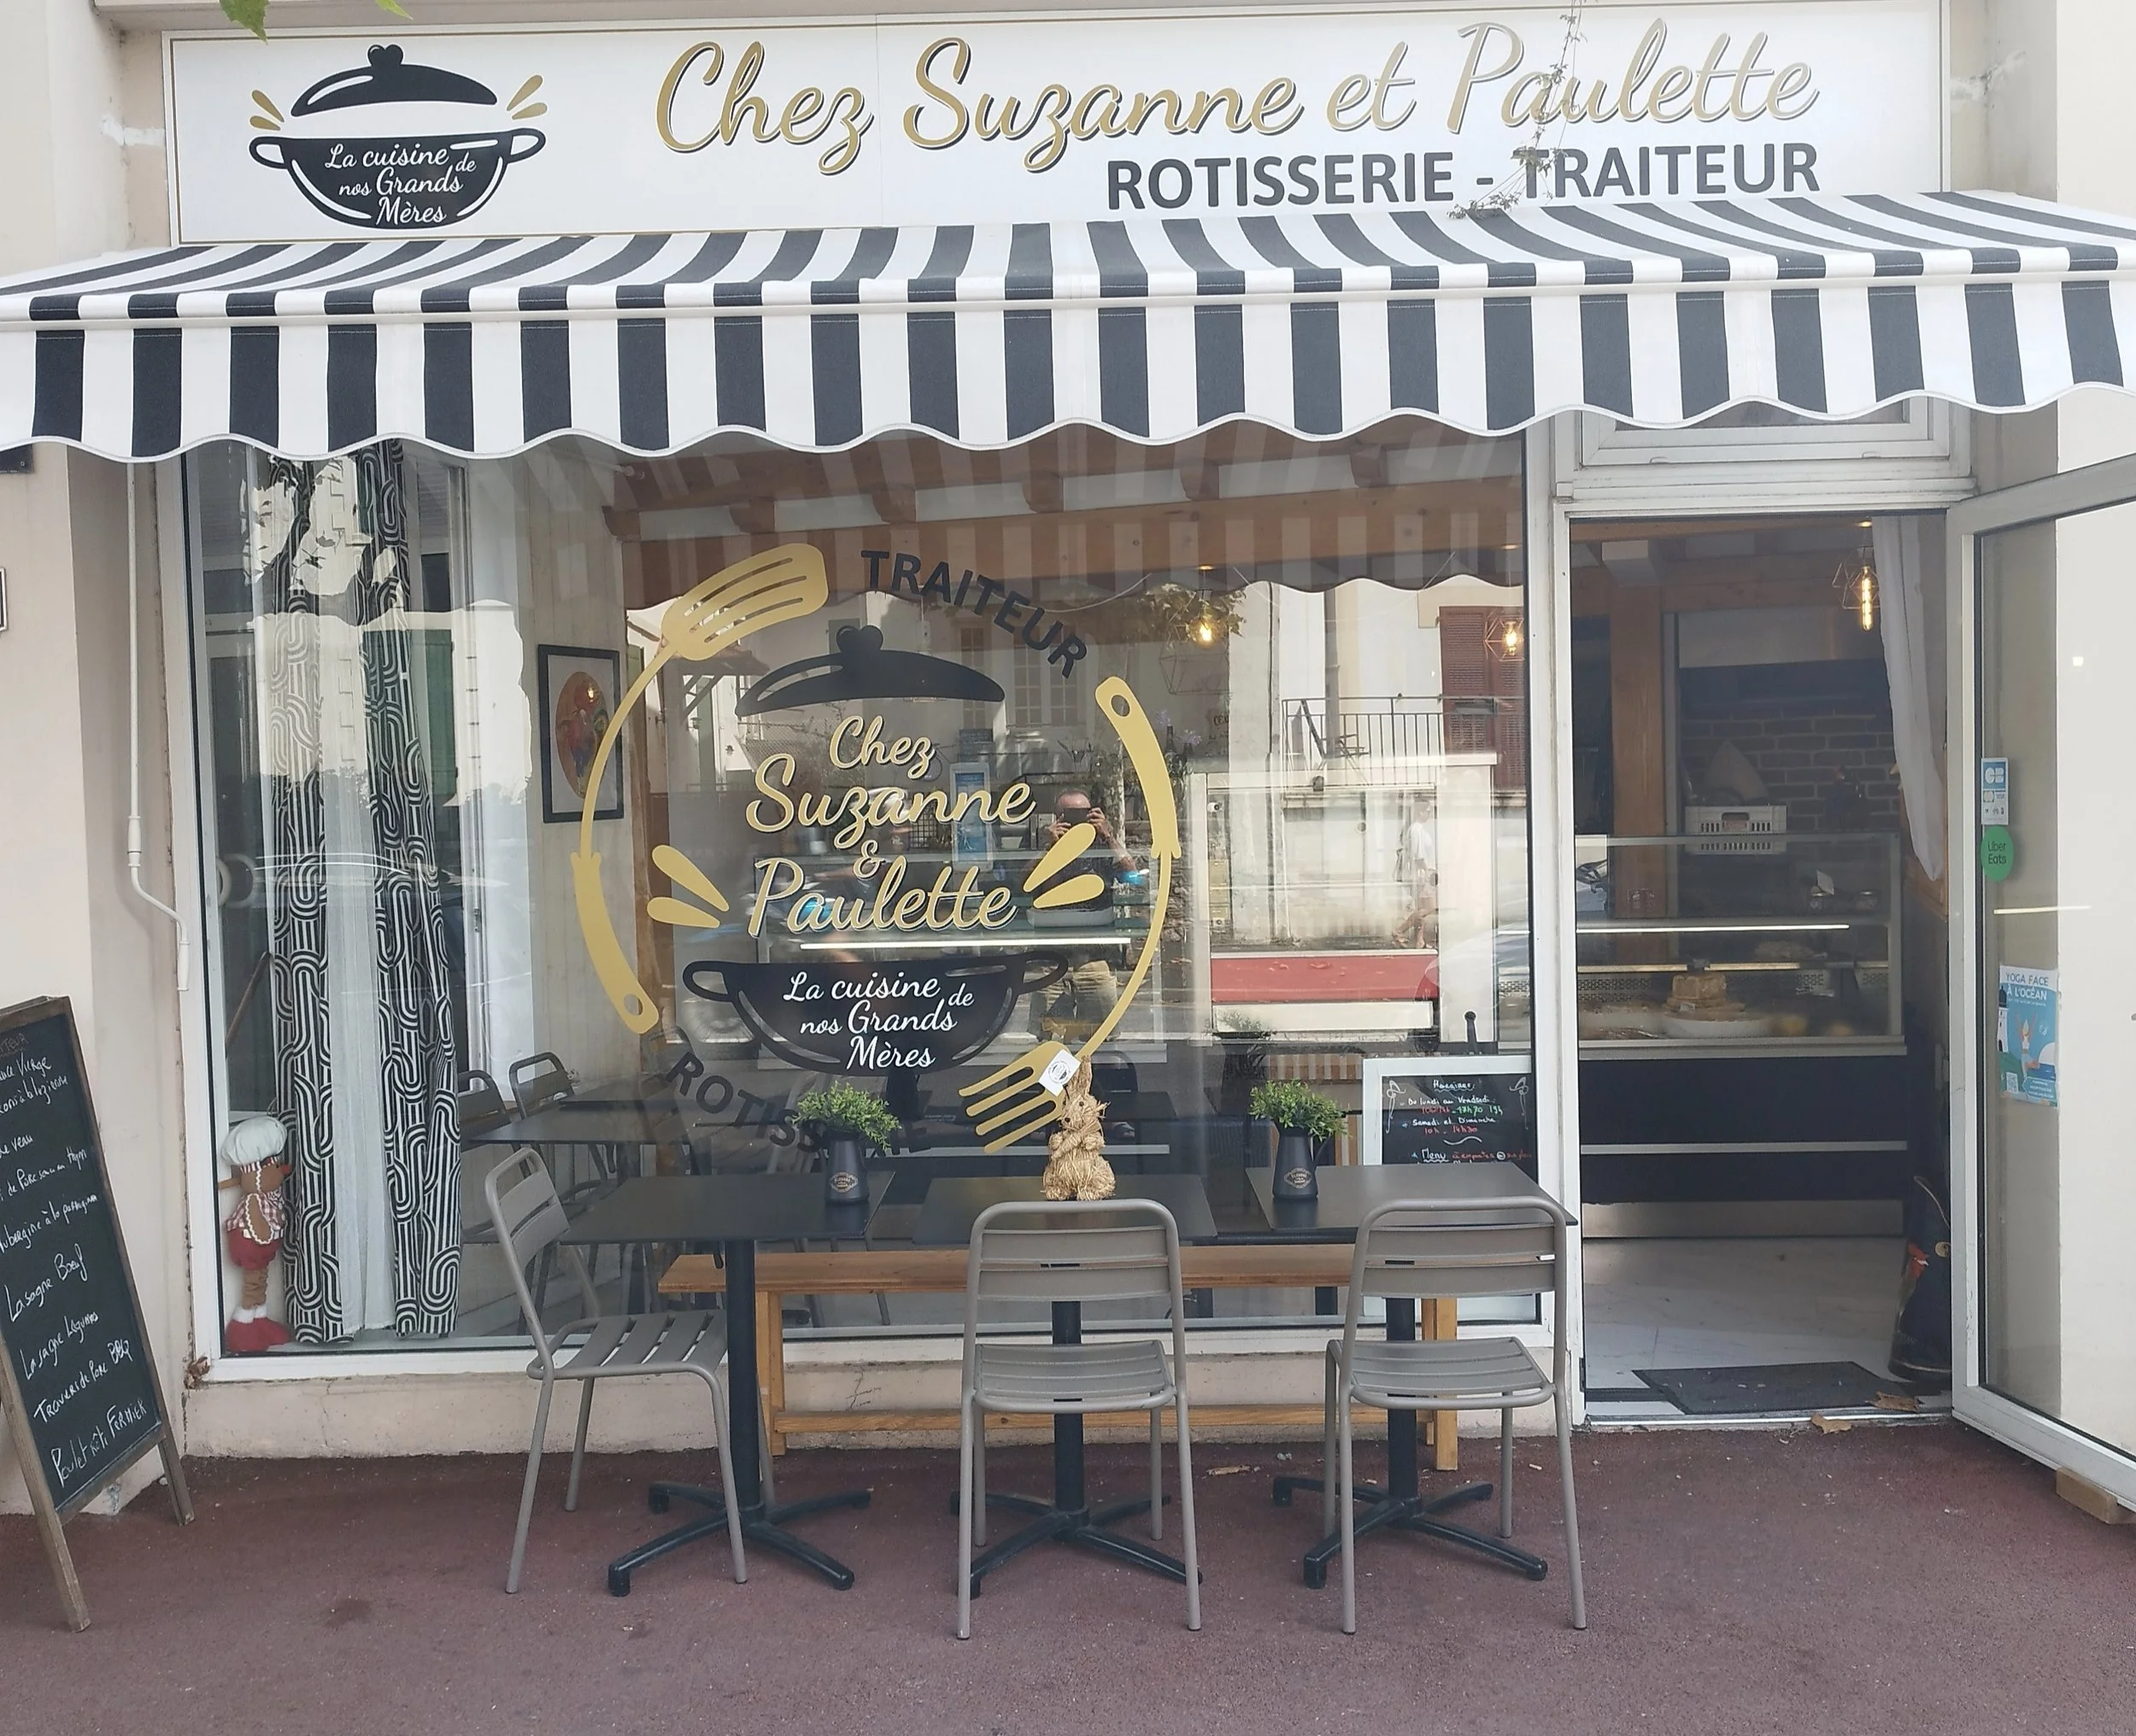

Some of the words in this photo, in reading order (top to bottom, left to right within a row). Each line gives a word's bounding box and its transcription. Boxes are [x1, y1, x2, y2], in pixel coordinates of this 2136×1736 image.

[655, 40, 874, 177] Chez
[903, 36, 1304, 173] Suzanne
[1325, 40, 1417, 132] et
[1447, 17, 1821, 135] Paulette
[325, 143, 357, 168] La
[362, 143, 449, 167] cuisine
[455, 151, 477, 172] de
[338, 181, 373, 196] nos
[376, 166, 464, 196] Grands
[1107, 151, 1454, 210] ROTISSERIE
[1517, 143, 1821, 201] TRAITEUR
[376, 196, 447, 226] Mères
[860, 549, 1088, 679] TRAITEUR
[830, 715, 936, 780] Chez
[745, 753, 1036, 850] Suzanne
[853, 839, 887, 881] &
[1987, 841, 2006, 852] Uber
[1987, 853, 2007, 865] Eats
[747, 855, 1018, 939] Paulette
[783, 971, 824, 1001] La
[830, 971, 941, 1000] cuisine
[948, 982, 975, 1006] de
[2005, 972, 2026, 984] YOGA
[2028, 975, 2049, 987] FACE
[800, 1018, 842, 1034] nos
[848, 998, 957, 1034] Grands
[845, 1035, 936, 1070] Mères
[4, 1284, 54, 1323] Lasagne
[20, 1333, 64, 1381] Lasagne
